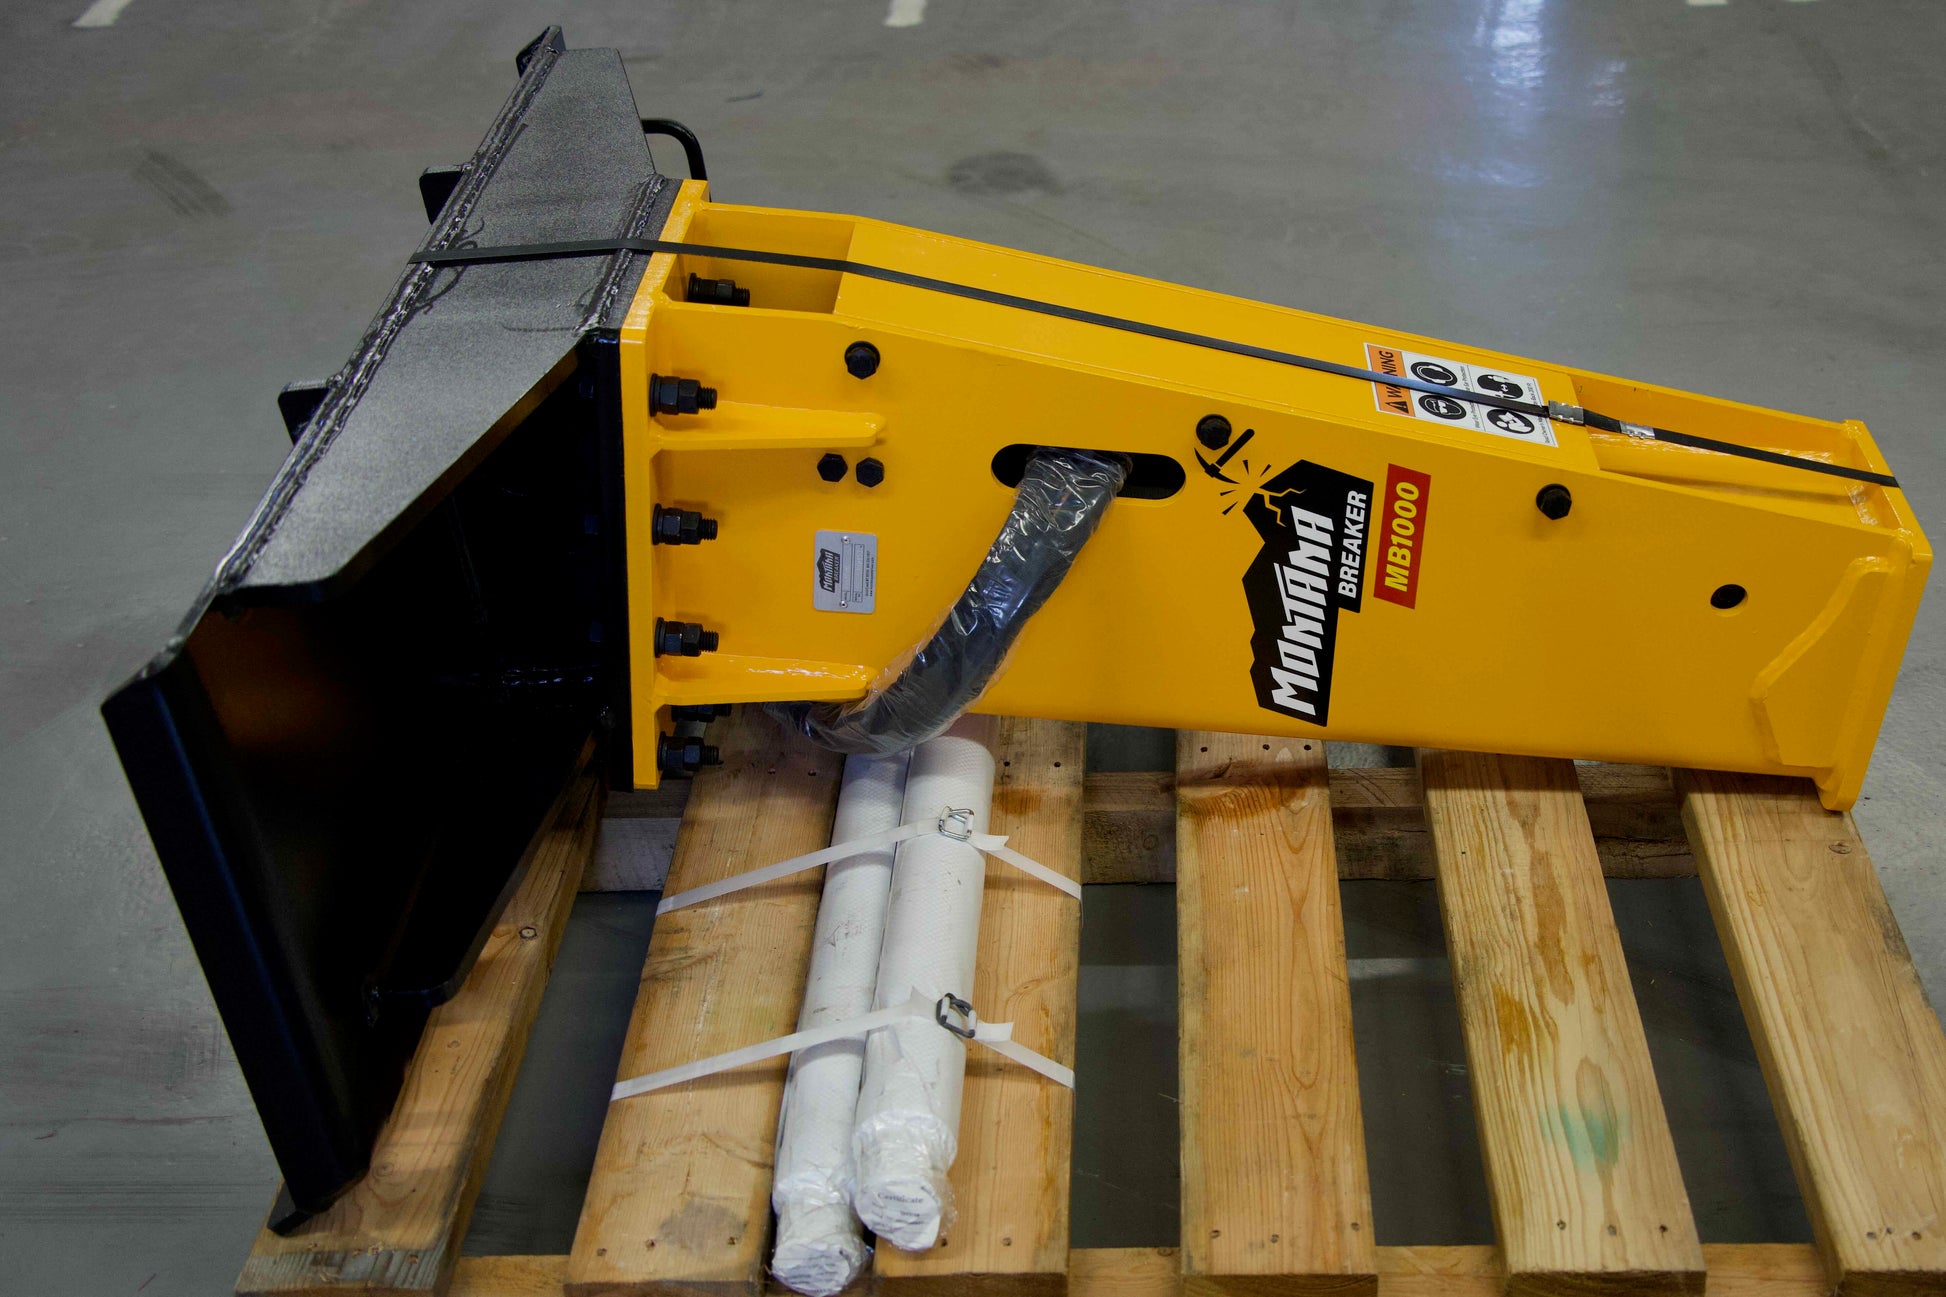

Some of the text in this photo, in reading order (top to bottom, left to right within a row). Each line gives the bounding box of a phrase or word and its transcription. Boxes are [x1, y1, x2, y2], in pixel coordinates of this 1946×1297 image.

[1337, 490, 1367, 598] BREAKER
[1384, 481, 1420, 592] MB1000
[1270, 505, 1335, 716] MONTANA
